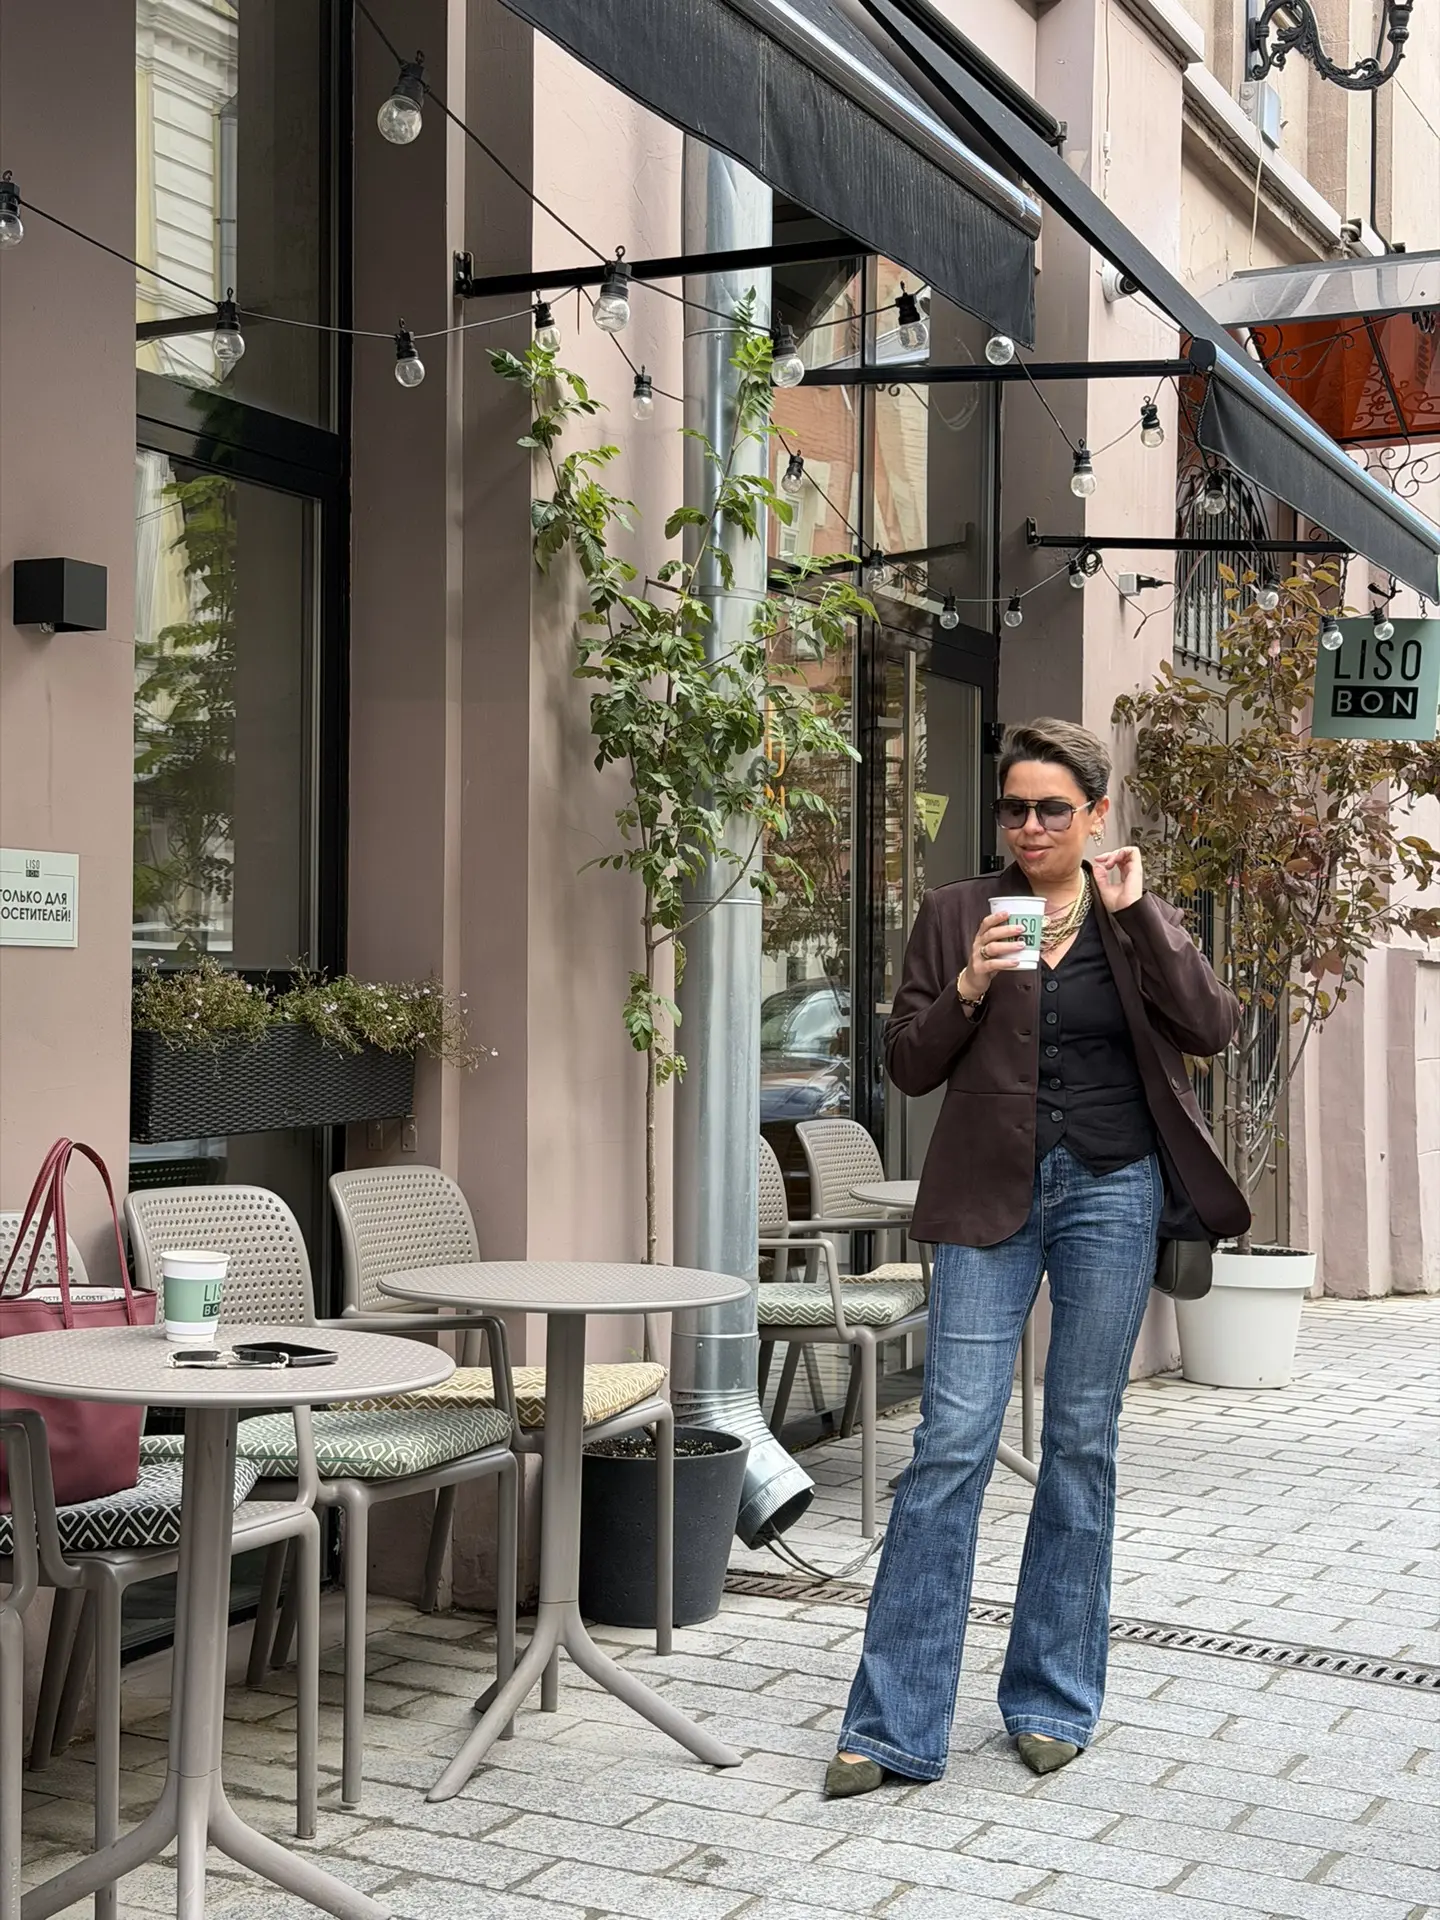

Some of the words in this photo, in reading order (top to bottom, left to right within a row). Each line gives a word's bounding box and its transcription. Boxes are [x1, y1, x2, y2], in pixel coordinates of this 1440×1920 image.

[1334, 639, 1422, 681] LISO
[1336, 690, 1413, 714] BON
[26, 860, 40, 869] LISO
[0, 889, 42, 904] ОЛЬКО
[45, 892, 67, 905] ДЛЯ
